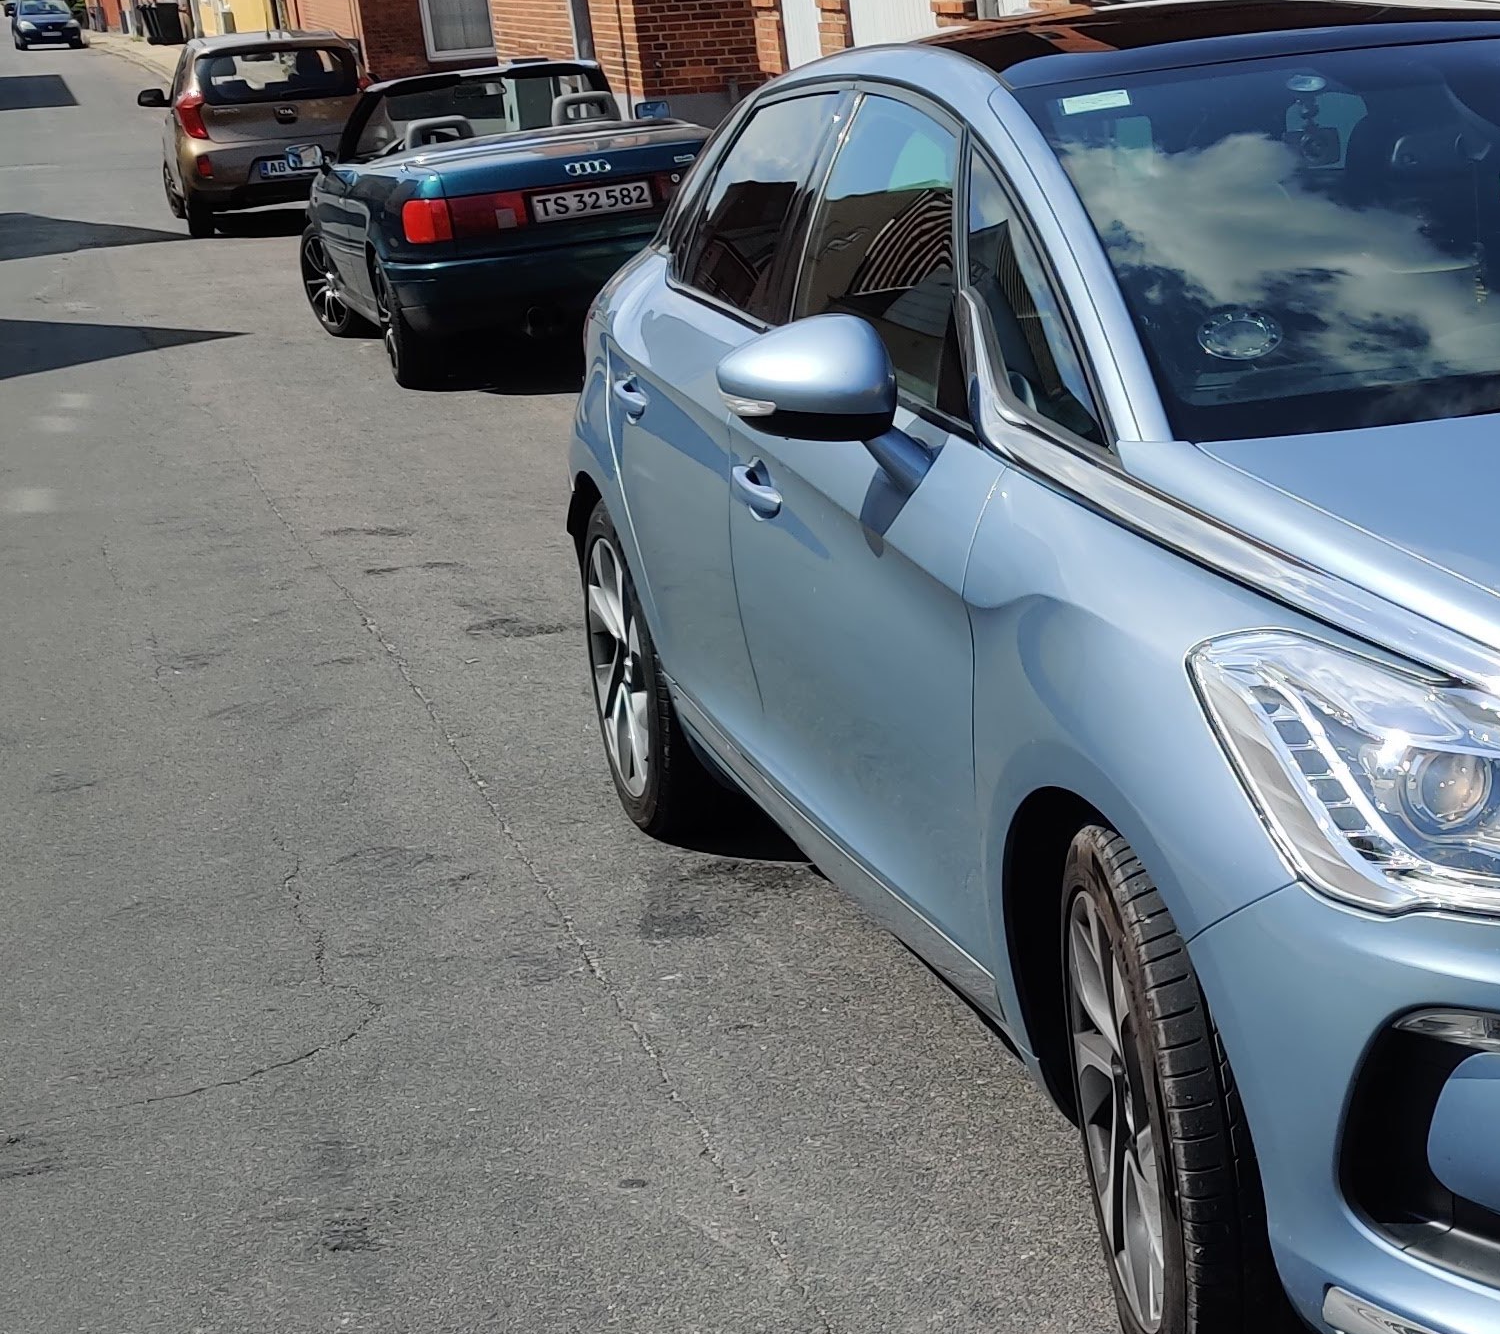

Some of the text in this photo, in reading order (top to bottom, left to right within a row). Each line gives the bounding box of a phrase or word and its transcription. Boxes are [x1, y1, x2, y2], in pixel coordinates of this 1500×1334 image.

[270, 161, 286, 173] AB
[536, 185, 648, 216] TS 32 582
